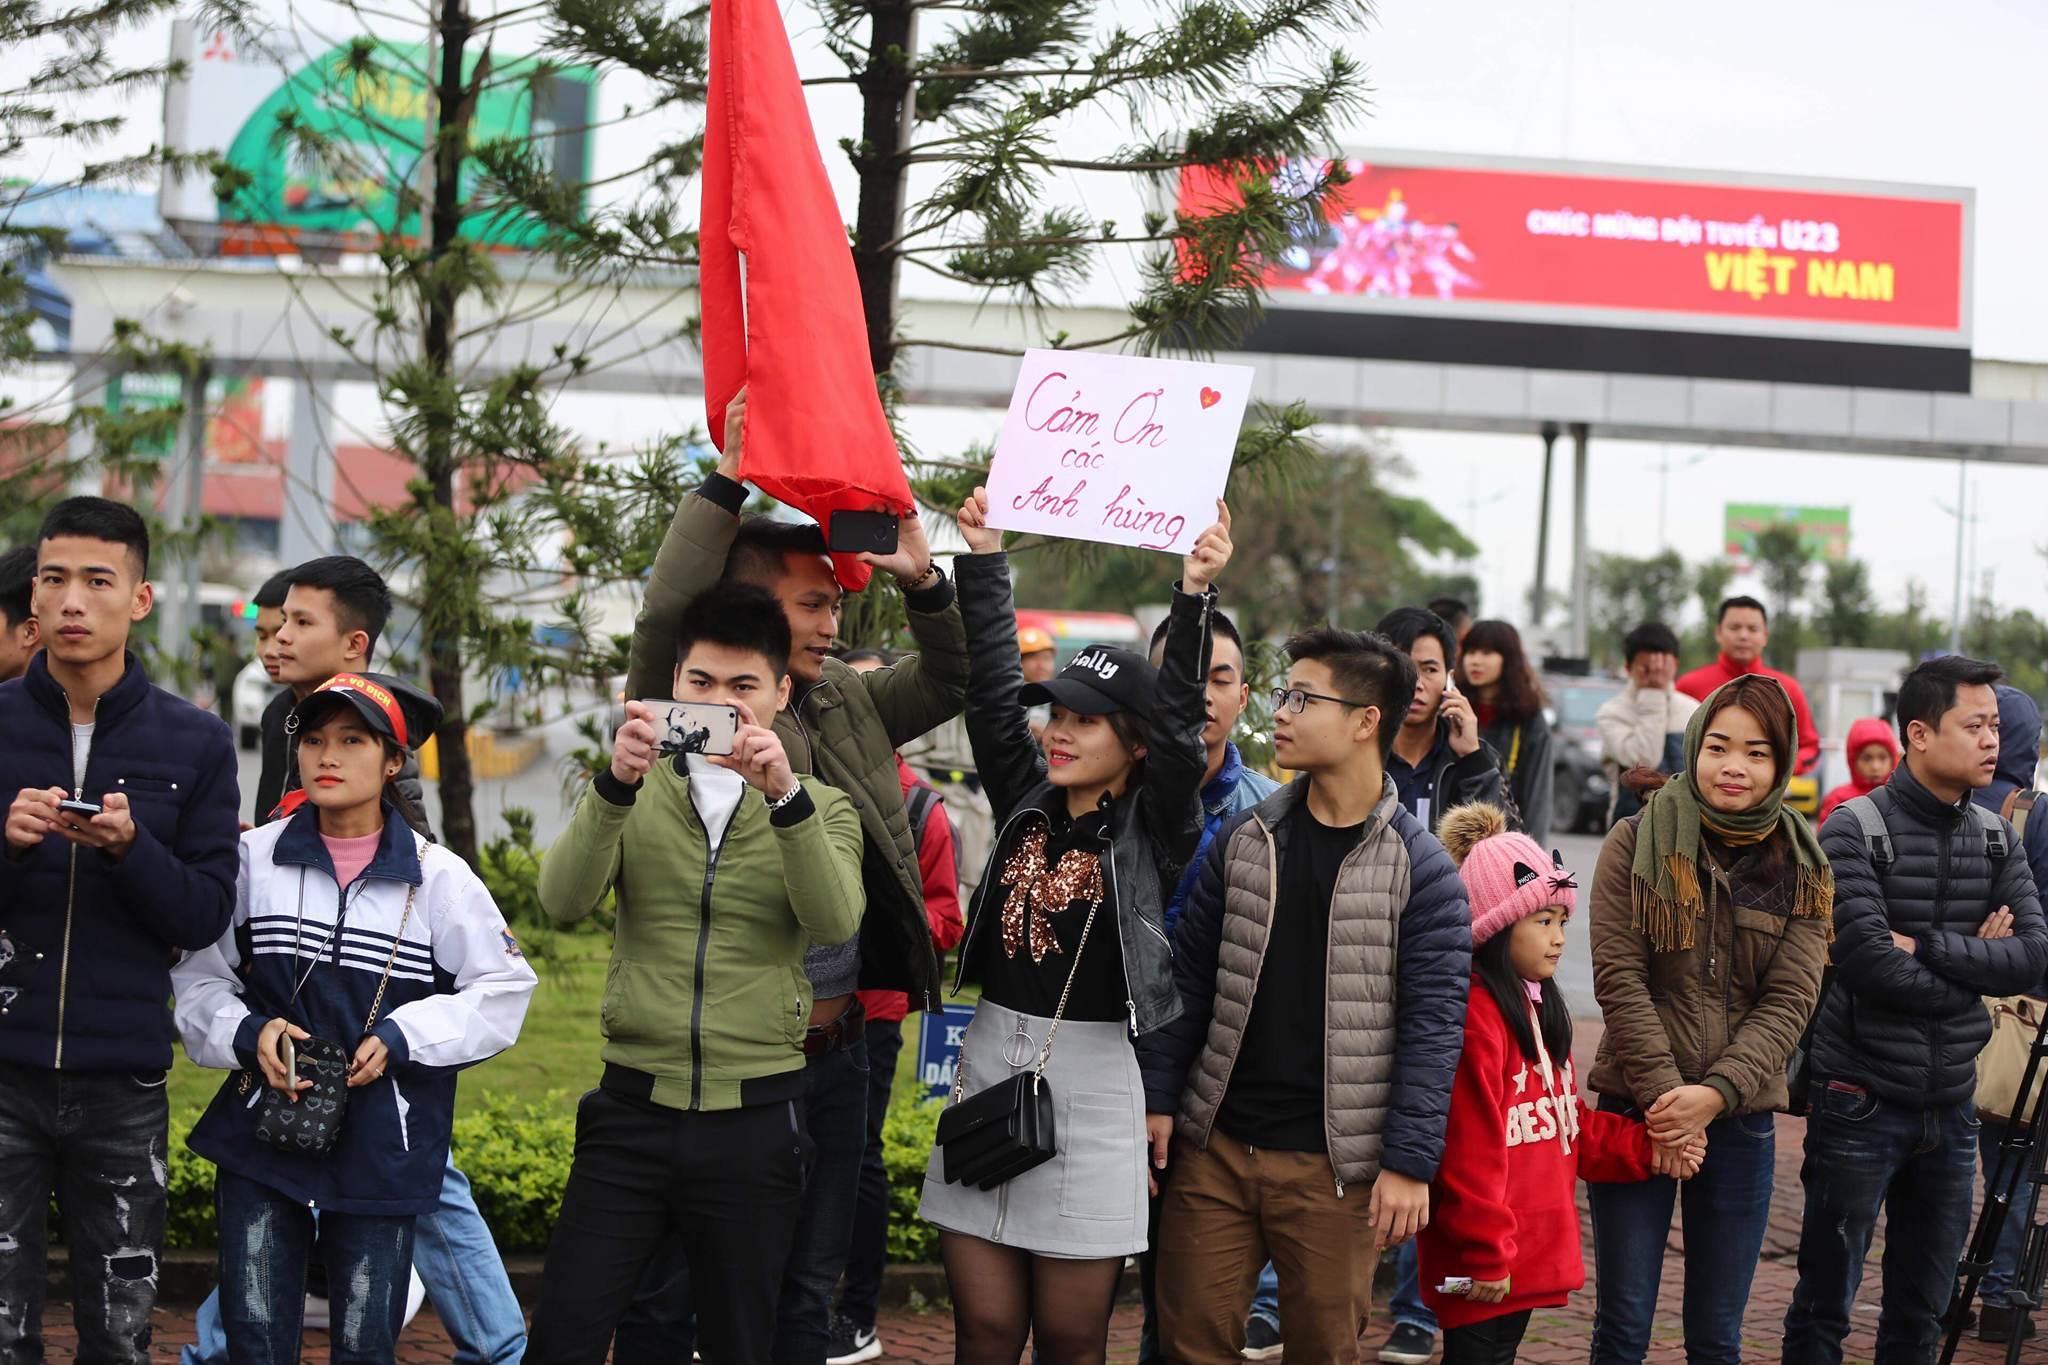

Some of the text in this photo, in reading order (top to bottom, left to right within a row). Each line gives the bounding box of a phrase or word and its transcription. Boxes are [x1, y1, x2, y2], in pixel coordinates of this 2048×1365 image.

[1779, 219, 1840, 253] U23
[1704, 247, 1895, 302] VIỆT NAM
[1025, 371, 1100, 436] Cảm
[1060, 440, 1105, 470] các
[1012, 475, 1186, 550] Anh hùng
[1517, 872, 1536, 886] PHOTO
